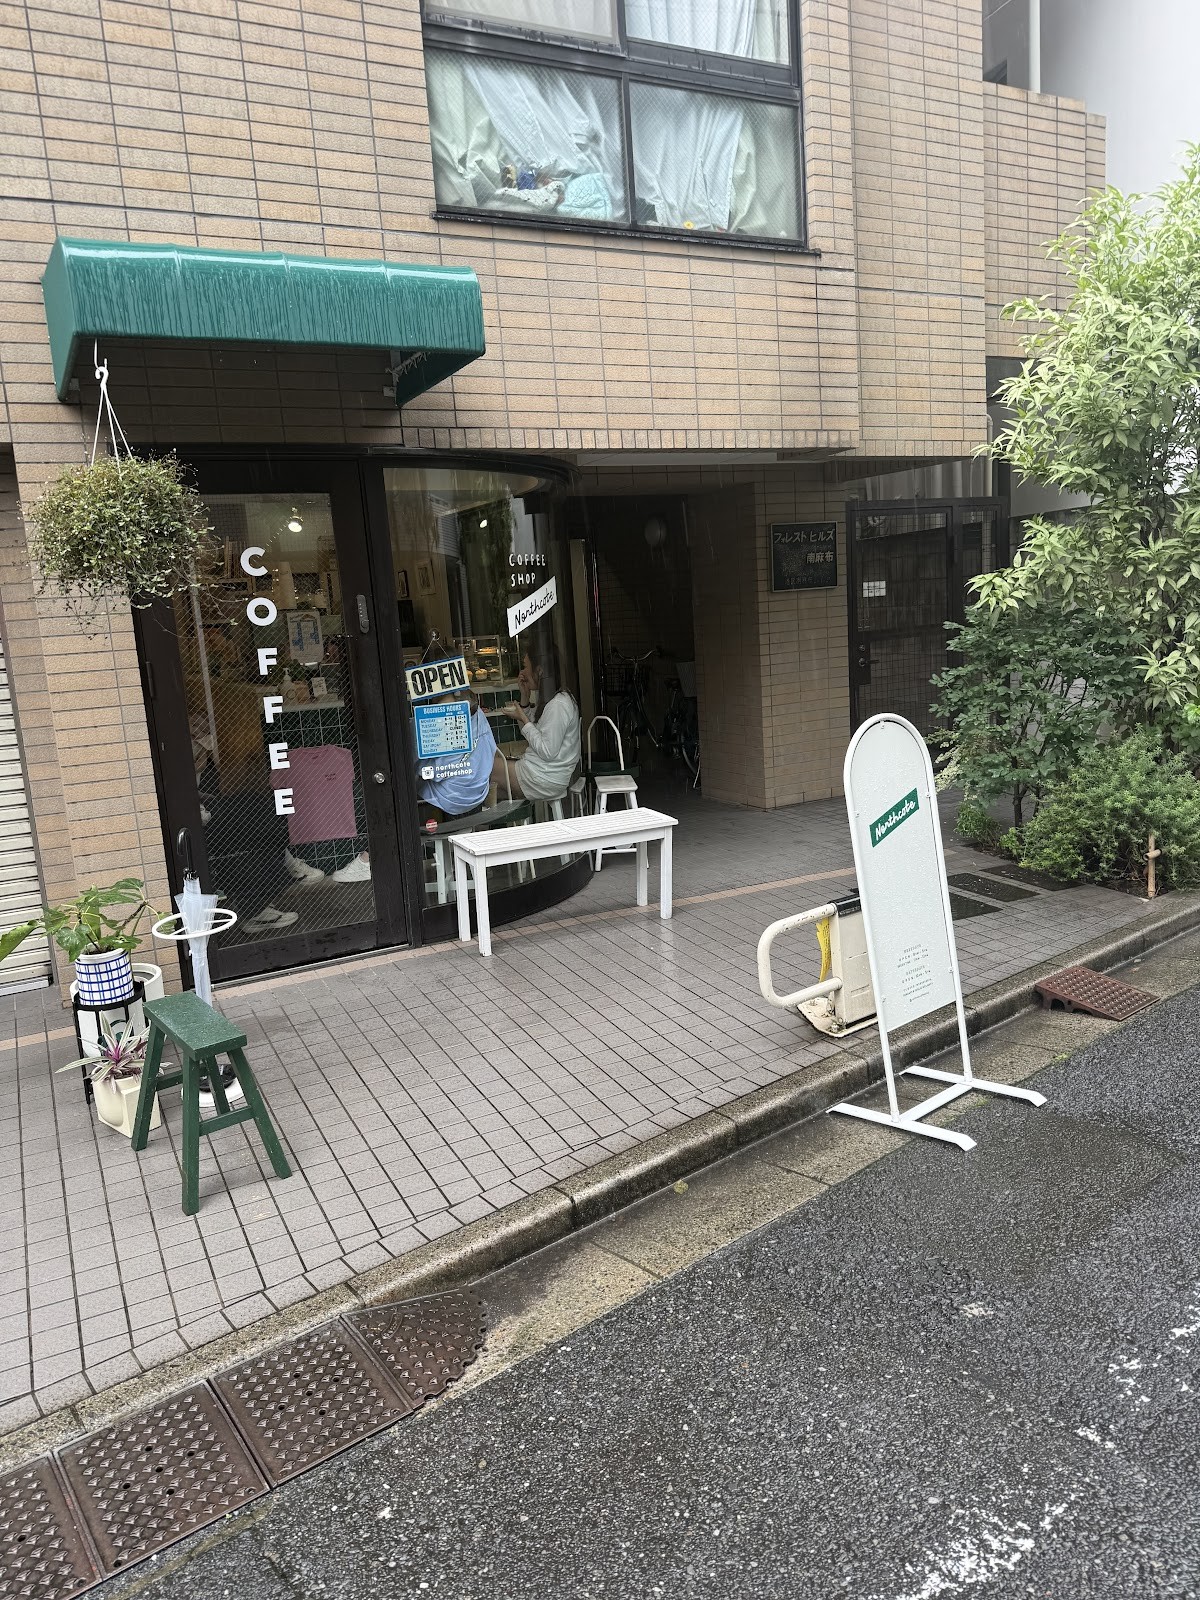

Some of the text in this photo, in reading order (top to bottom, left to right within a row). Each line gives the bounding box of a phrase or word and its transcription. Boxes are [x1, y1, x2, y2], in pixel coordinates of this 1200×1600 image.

[509, 553, 546, 567] COFFEE
[806, 551, 834, 564] 南麻布
[511, 572, 536, 587] SHOP
[514, 588, 555, 629] Northcote
[241, 547, 295, 815] COFFEE
[410, 660, 466, 696] OPEN
[423, 706, 446, 715] BUSINESS
[446, 704, 462, 712] HOURS
[435, 762, 471, 771] northcote
[436, 768, 473, 778] coffeeshop
[875, 799, 916, 841] Northcote
